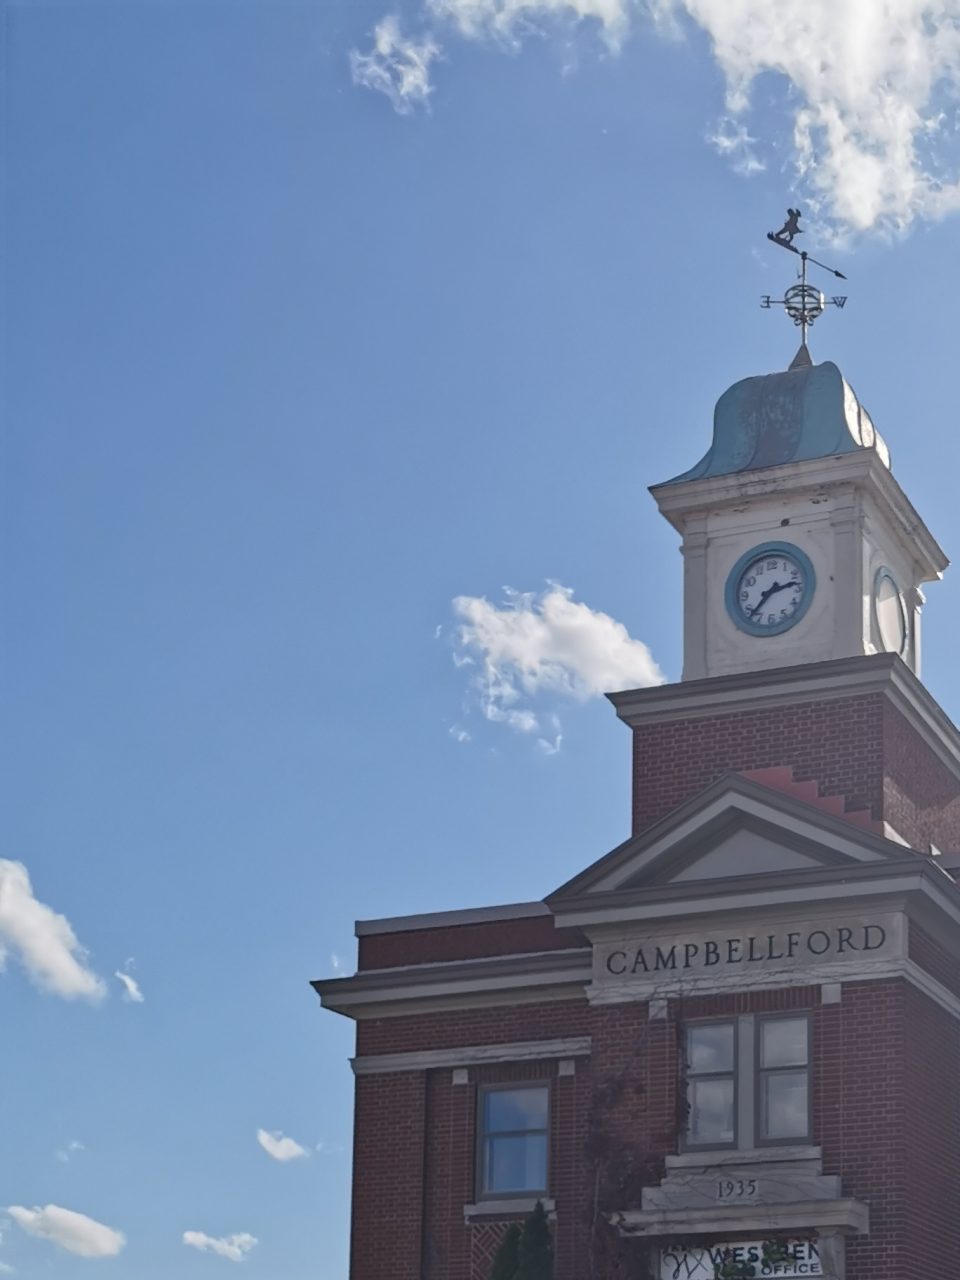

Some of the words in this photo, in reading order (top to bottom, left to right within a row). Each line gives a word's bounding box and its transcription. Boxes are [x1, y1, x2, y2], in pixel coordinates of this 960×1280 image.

[606, 924, 887, 975] CAMPBELLFORD
[717, 1179, 757, 1198] 1935
[709, 1242, 820, 1266] WESEN
[760, 1262, 820, 1276] OFFICE
